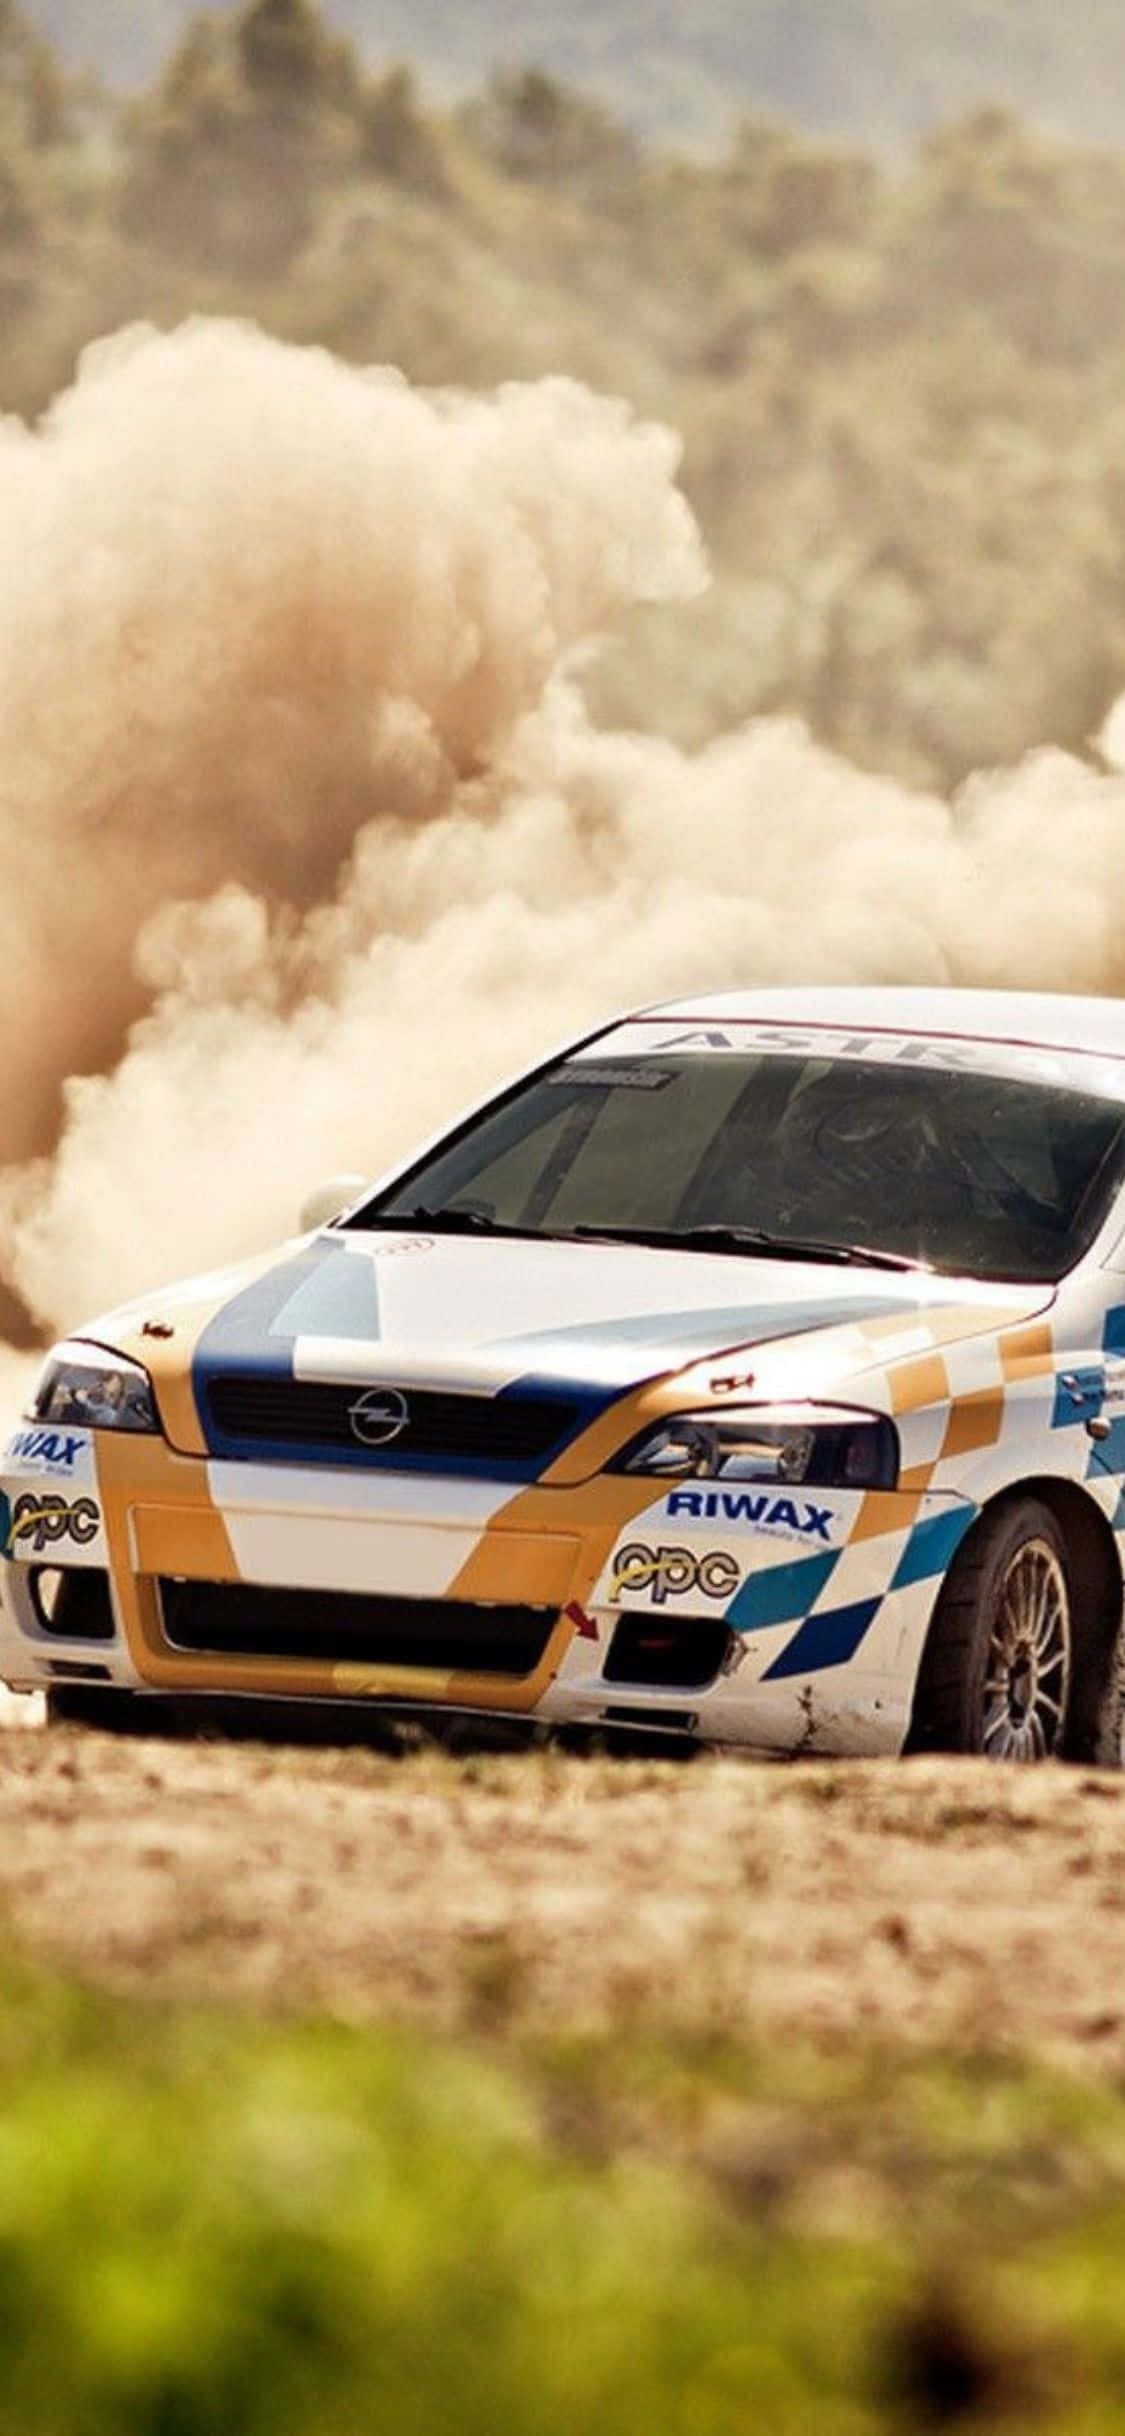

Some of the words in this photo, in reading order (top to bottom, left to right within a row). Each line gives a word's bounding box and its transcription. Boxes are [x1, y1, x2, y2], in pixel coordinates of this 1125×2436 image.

[13, 1493, 100, 1551] opc
[666, 1491, 834, 1541] RIWAX
[613, 1542, 740, 1604] opc
